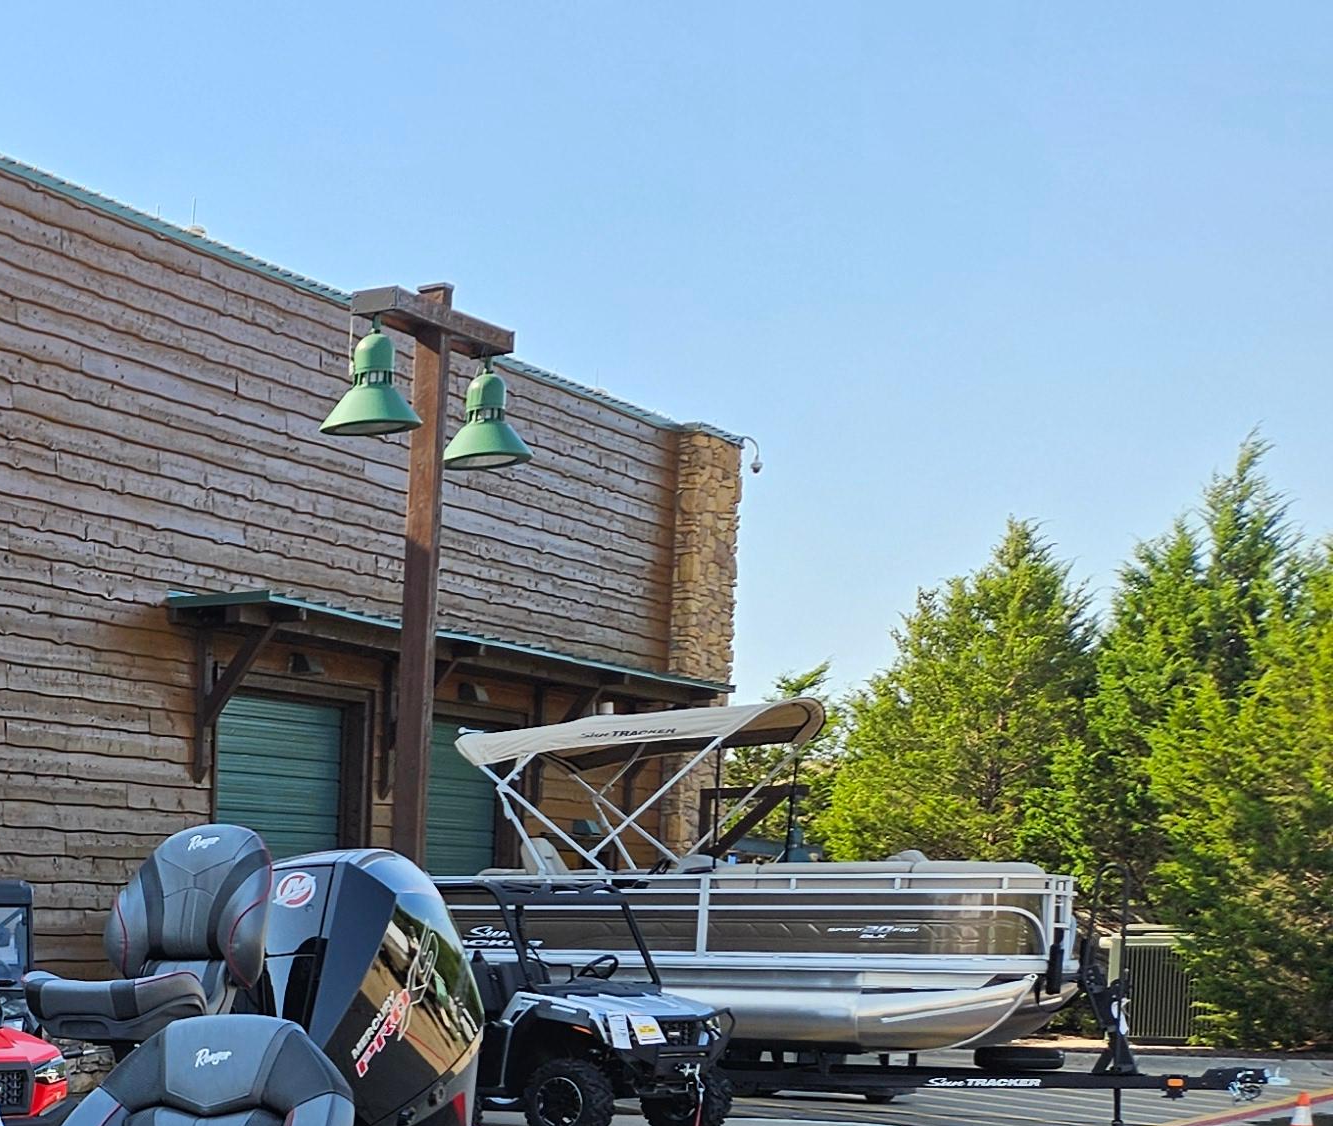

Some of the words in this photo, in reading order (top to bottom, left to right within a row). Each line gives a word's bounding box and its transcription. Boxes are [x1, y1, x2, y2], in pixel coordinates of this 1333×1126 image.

[188, 834, 220, 852] Ranger
[351, 990, 396, 1060] MERCURY
[355, 989, 411, 1078] PRO
[194, 1047, 233, 1069] Ranger
[923, 1077, 965, 1087] Sun
[965, 1078, 1042, 1087] TRACKER
